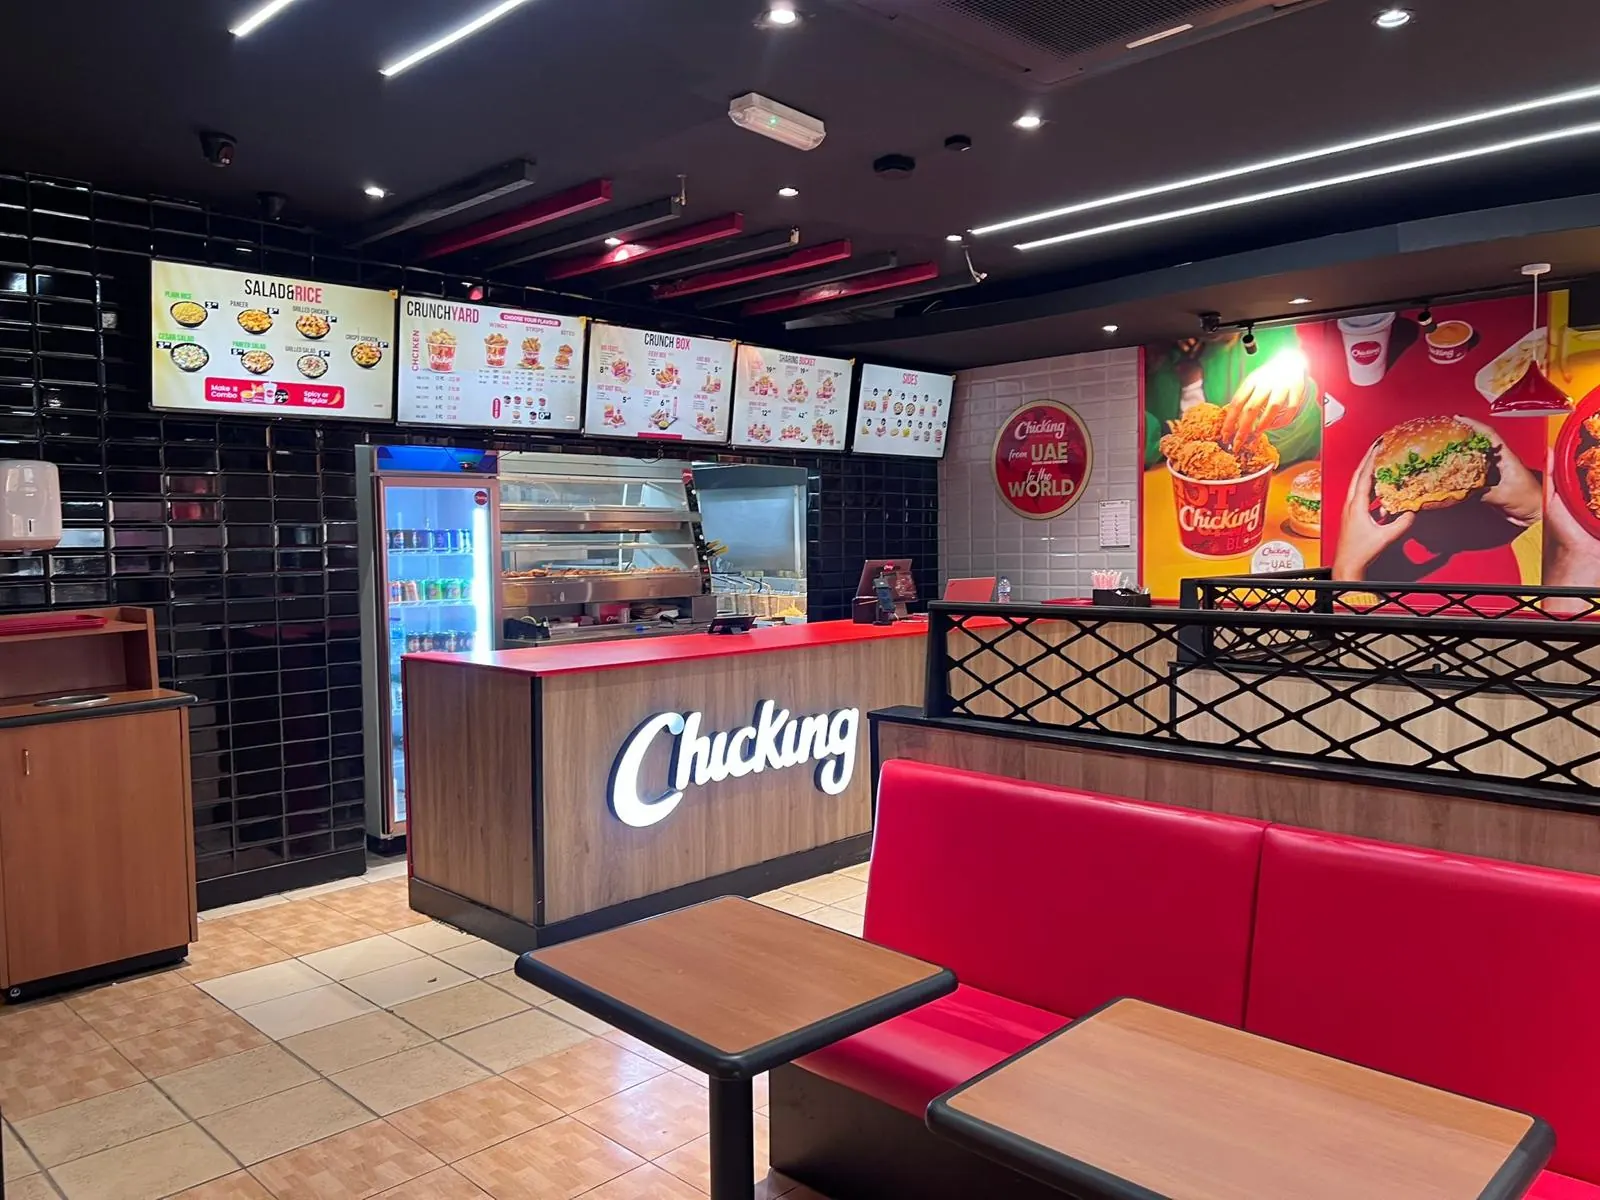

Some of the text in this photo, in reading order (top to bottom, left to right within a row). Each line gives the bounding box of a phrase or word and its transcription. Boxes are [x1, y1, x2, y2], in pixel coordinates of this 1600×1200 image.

[644, 333, 690, 350] CRUNCH BOX
[211, 384, 230, 392] Make
[211, 391, 237, 399] Combo
[304, 390, 320, 398] Spicy
[1014, 419, 1066, 440] Chicking
[1008, 441, 1068, 462] from UAE
[1036, 466, 1052, 484] the
[1008, 479, 1074, 498] WORLD
[1179, 500, 1261, 532] Chicking
[1271, 560, 1292, 569] UAE
[608, 699, 860, 827] Chicking
